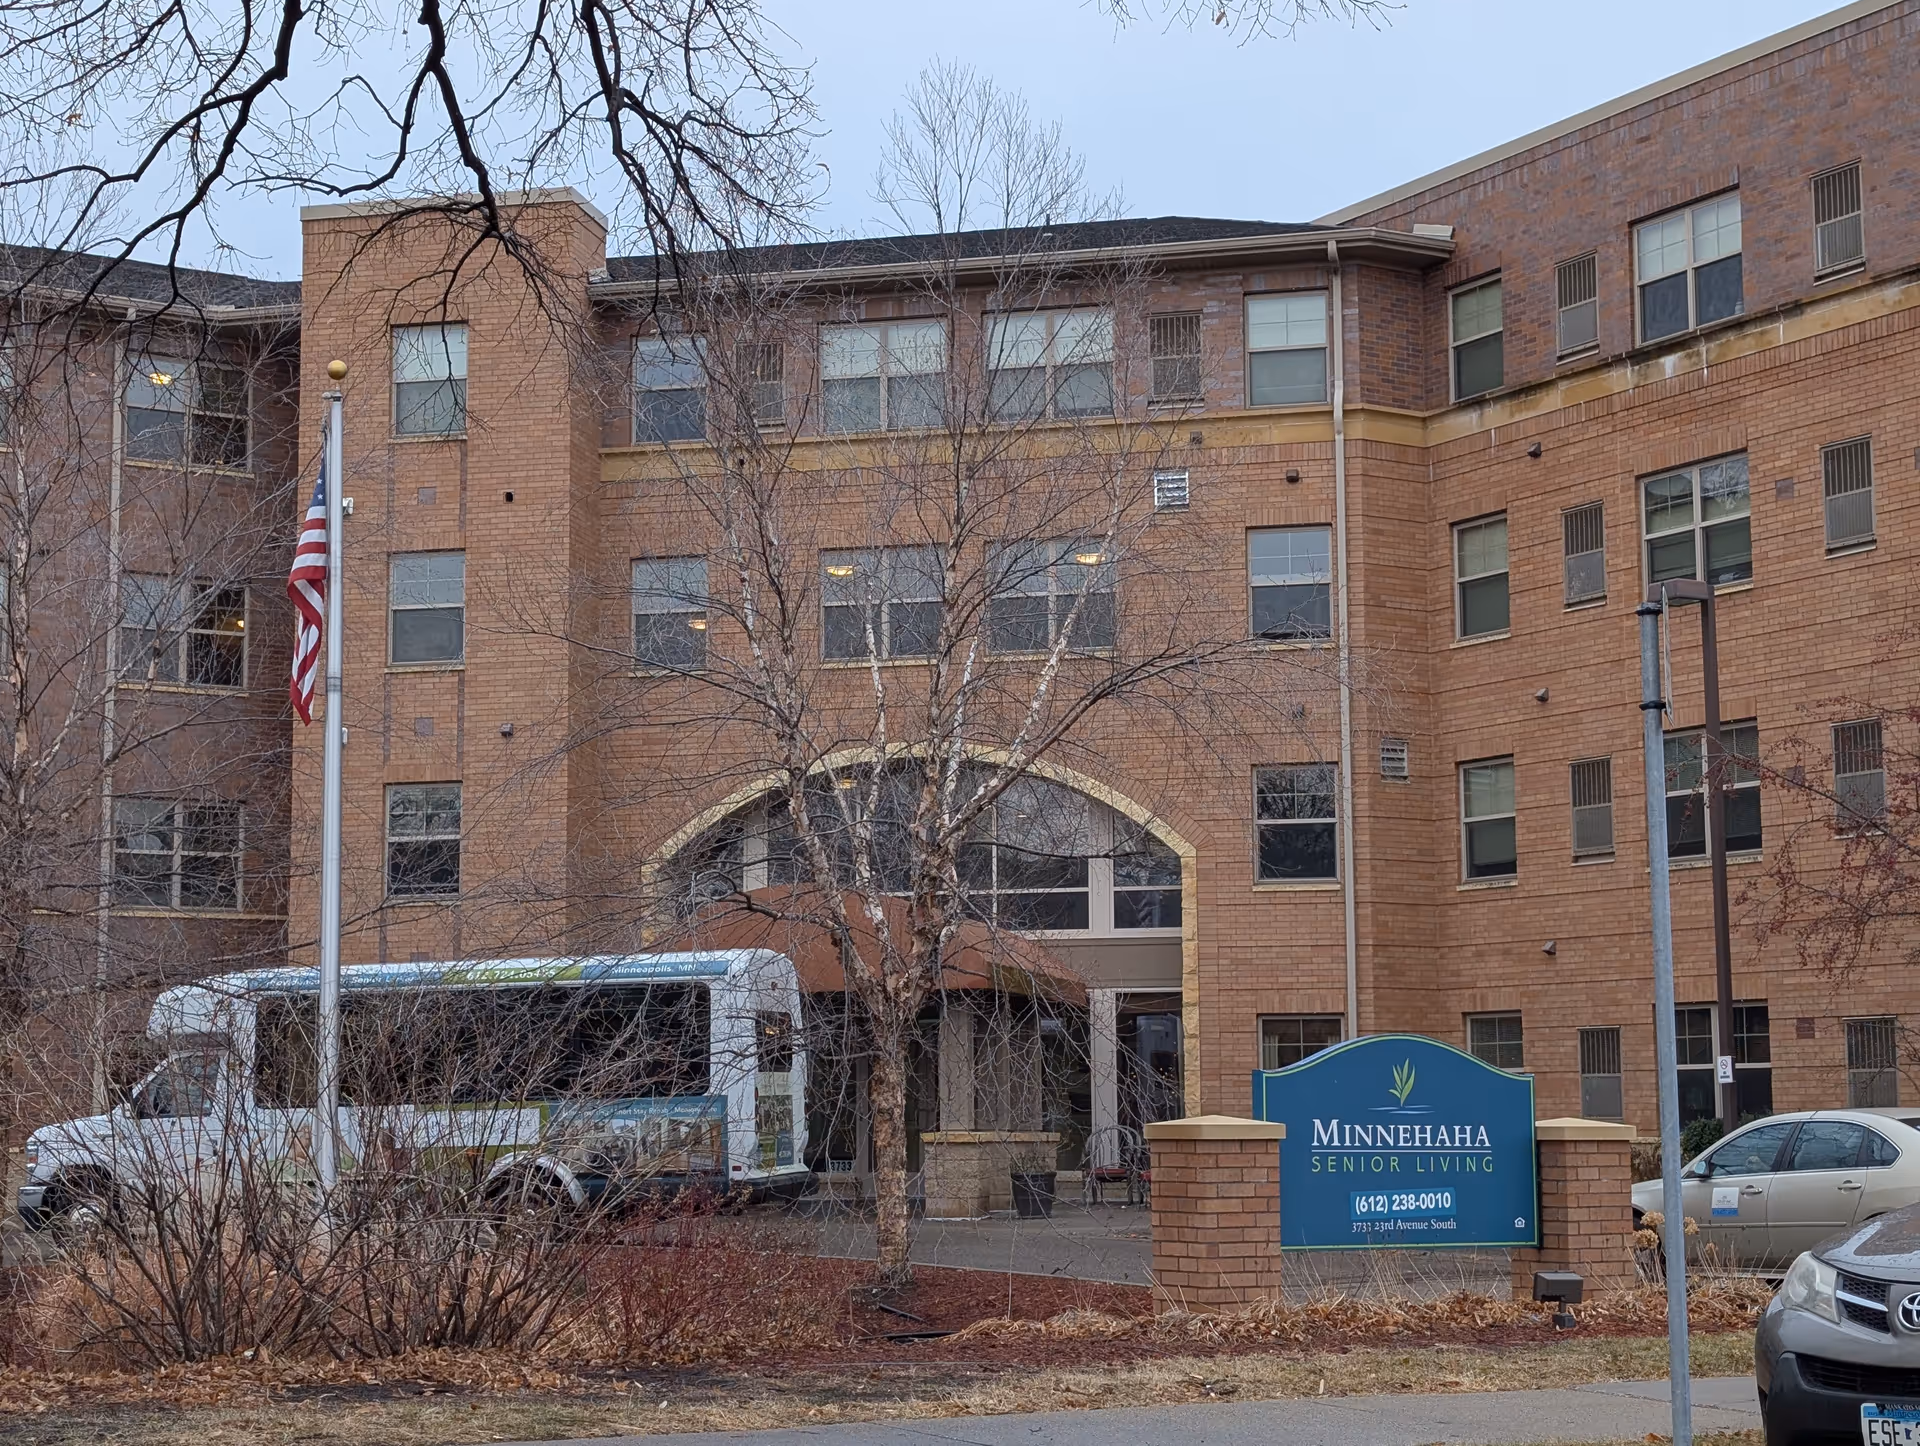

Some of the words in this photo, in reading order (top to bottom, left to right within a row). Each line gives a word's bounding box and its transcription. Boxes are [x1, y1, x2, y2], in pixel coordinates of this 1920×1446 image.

[678, 963, 697, 972] MN
[1311, 1118, 1491, 1147] MINNEHAHA
[1311, 1156, 1401, 1172] SENIOR
[1416, 1156, 1494, 1173] LIVING
[1355, 1195, 1388, 1215] (612)
[1392, 1192, 1451, 1211] 238-0010
[1374, 1219, 1394, 1232] 23rd
[1395, 1219, 1429, 1230] Avenue
[1430, 1218, 1457, 1230] South
